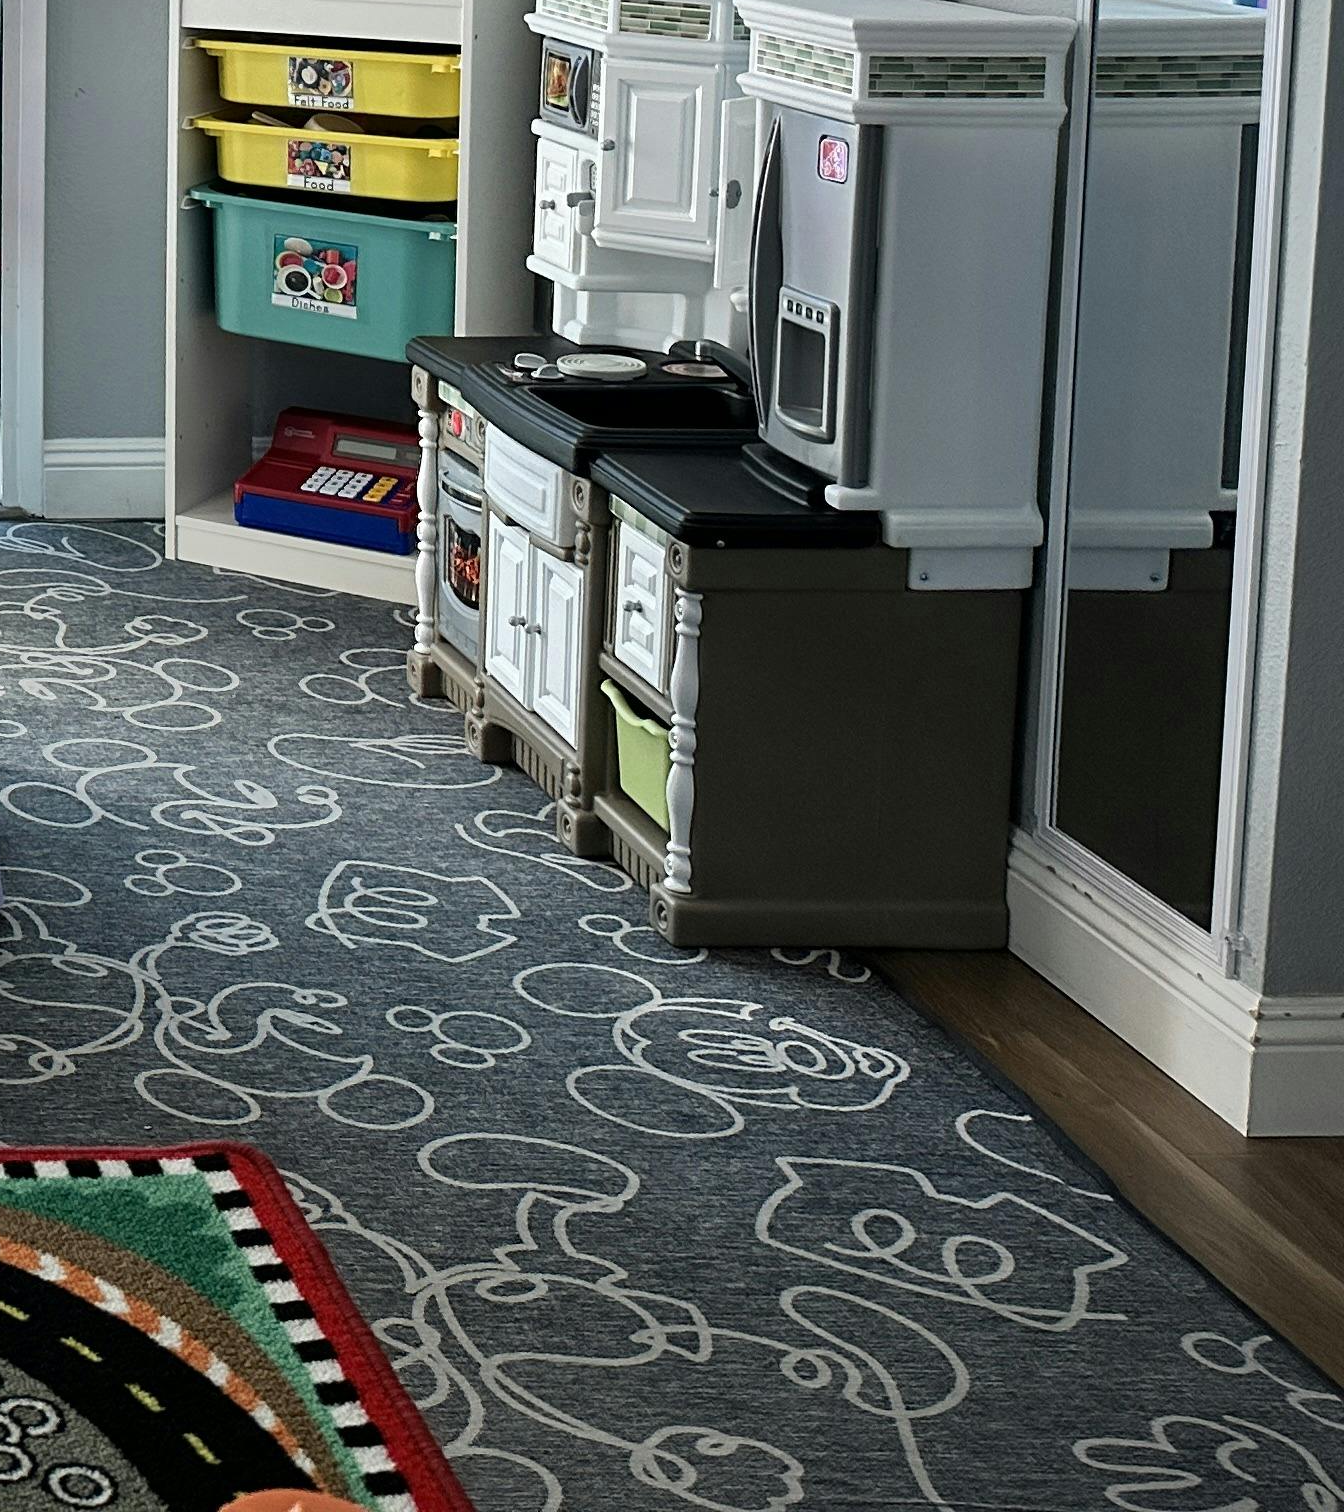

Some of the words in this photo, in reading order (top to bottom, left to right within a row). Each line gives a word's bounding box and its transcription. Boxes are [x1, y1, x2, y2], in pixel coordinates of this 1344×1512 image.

[294, 95, 317, 107] Felt
[321, 96, 350, 109] Food
[303, 175, 335, 192] Food
[291, 296, 330, 314] Dishes
